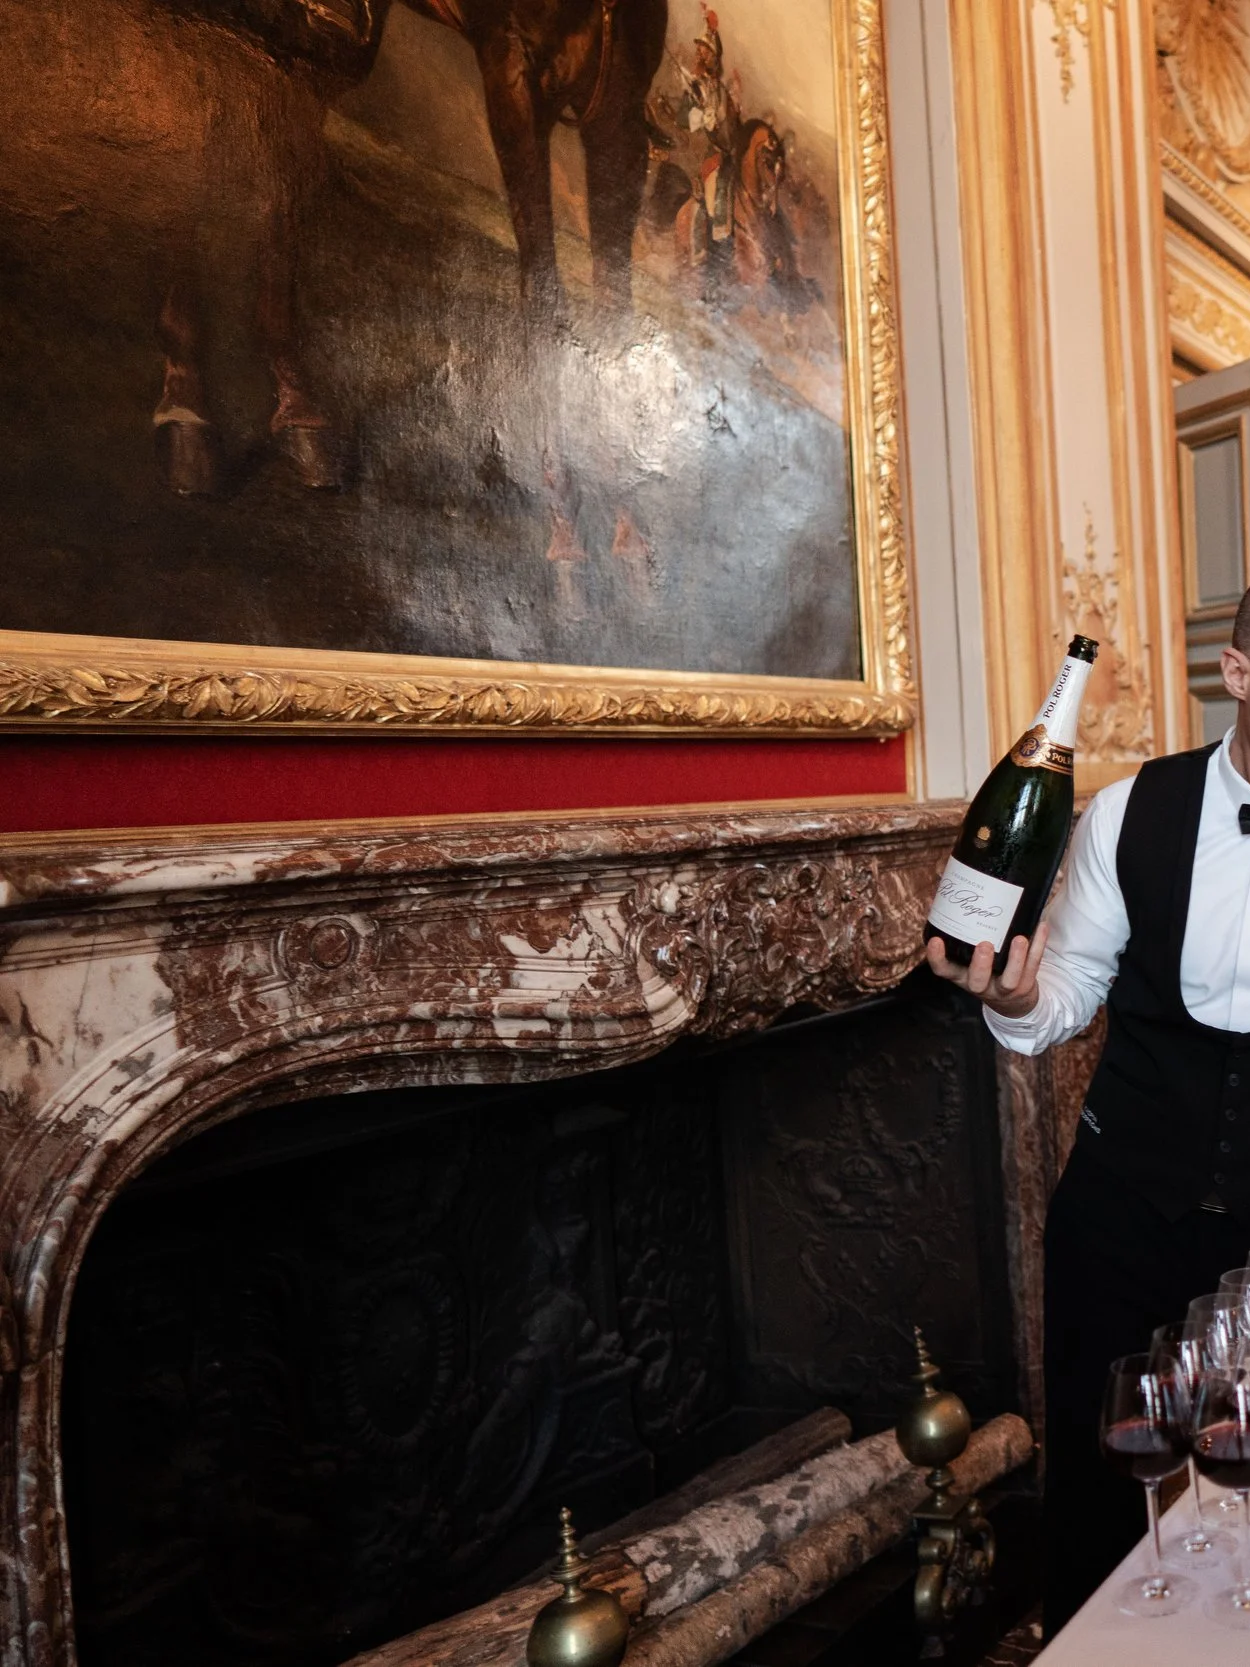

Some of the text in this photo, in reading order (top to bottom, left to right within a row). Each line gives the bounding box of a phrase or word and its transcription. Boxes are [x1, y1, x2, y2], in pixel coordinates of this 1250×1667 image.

[1043, 664, 1072, 718] POL ROGER
[938, 878, 1003, 917] Pol Roger
